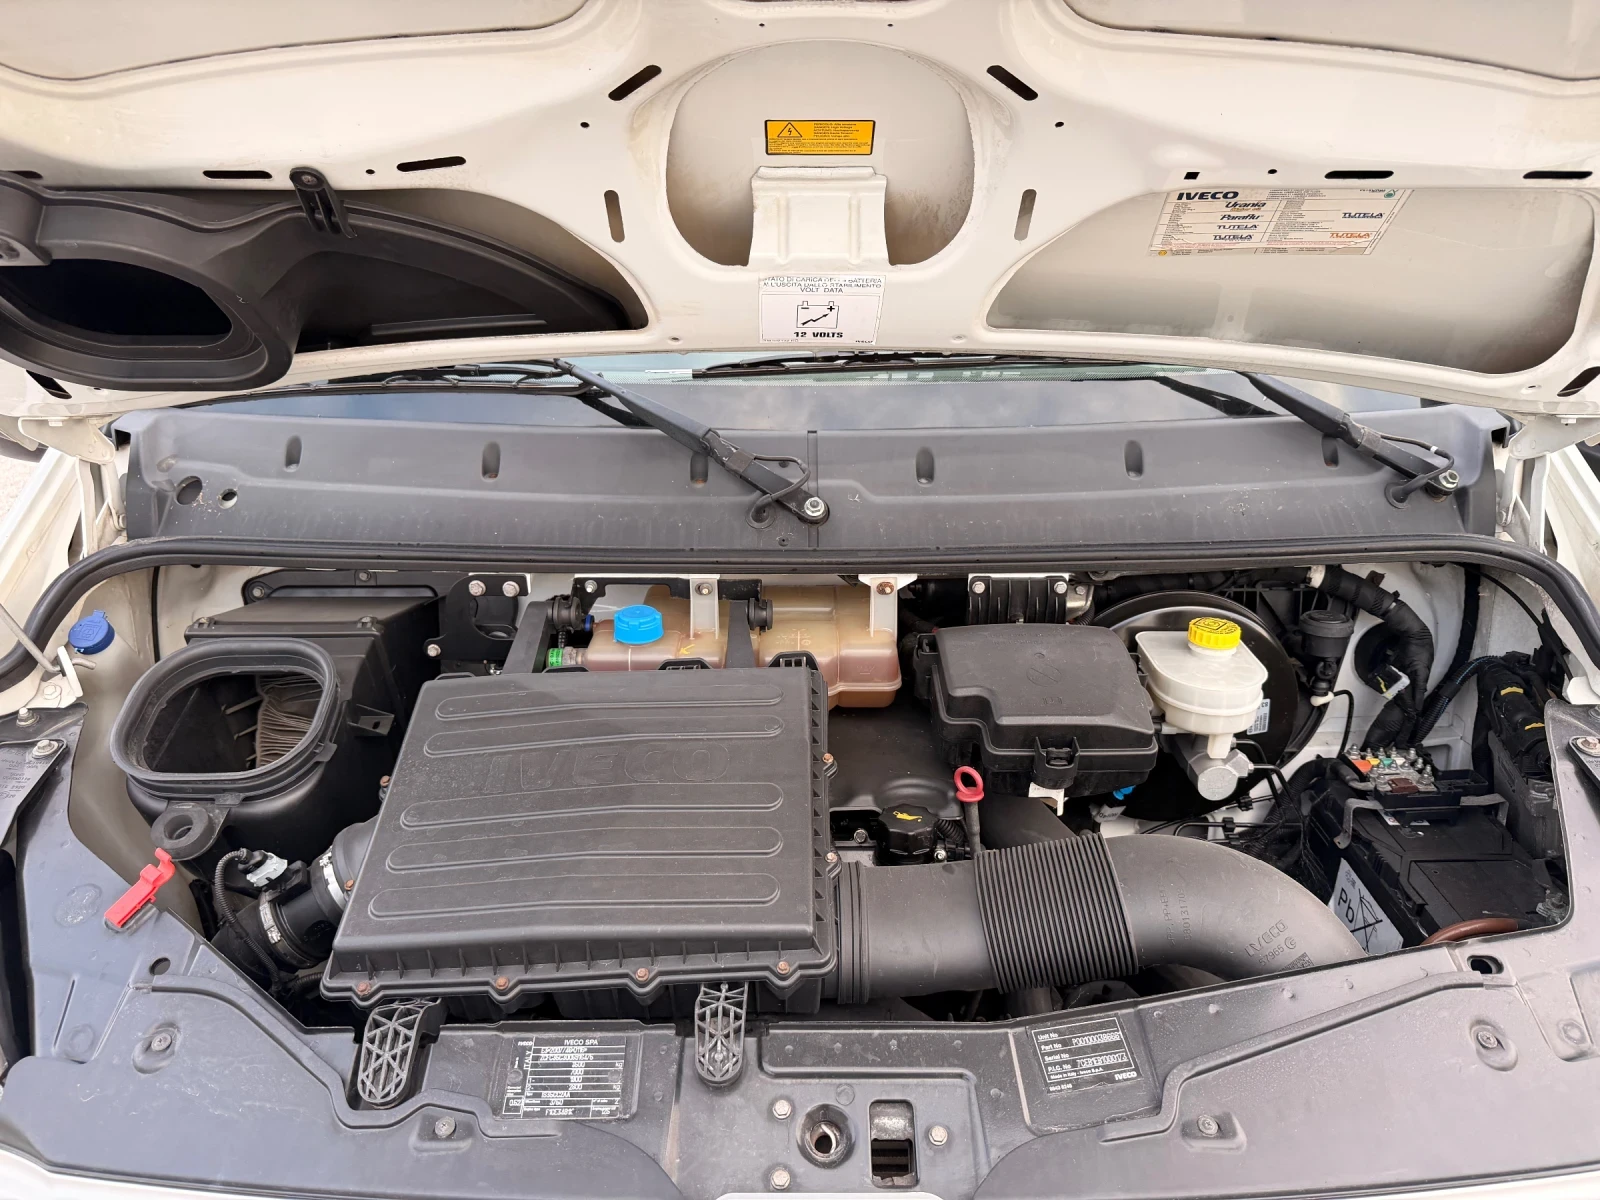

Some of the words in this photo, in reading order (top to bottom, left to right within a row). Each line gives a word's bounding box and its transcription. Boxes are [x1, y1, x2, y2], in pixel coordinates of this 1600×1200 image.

[1176, 191, 1239, 200] IVECO
[1224, 200, 1266, 208] Urania
[1220, 214, 1262, 222] Paraflu
[484, 743, 730, 794] IVECO
[1338, 887, 1355, 924] Pb
[1244, 918, 1289, 958] IVECO
[1258, 944, 1285, 967] 57965
[524, 1050, 532, 1069] ITALY
[1044, 1053, 1060, 1062] Serial
[1114, 1071, 1138, 1081] IVECO
